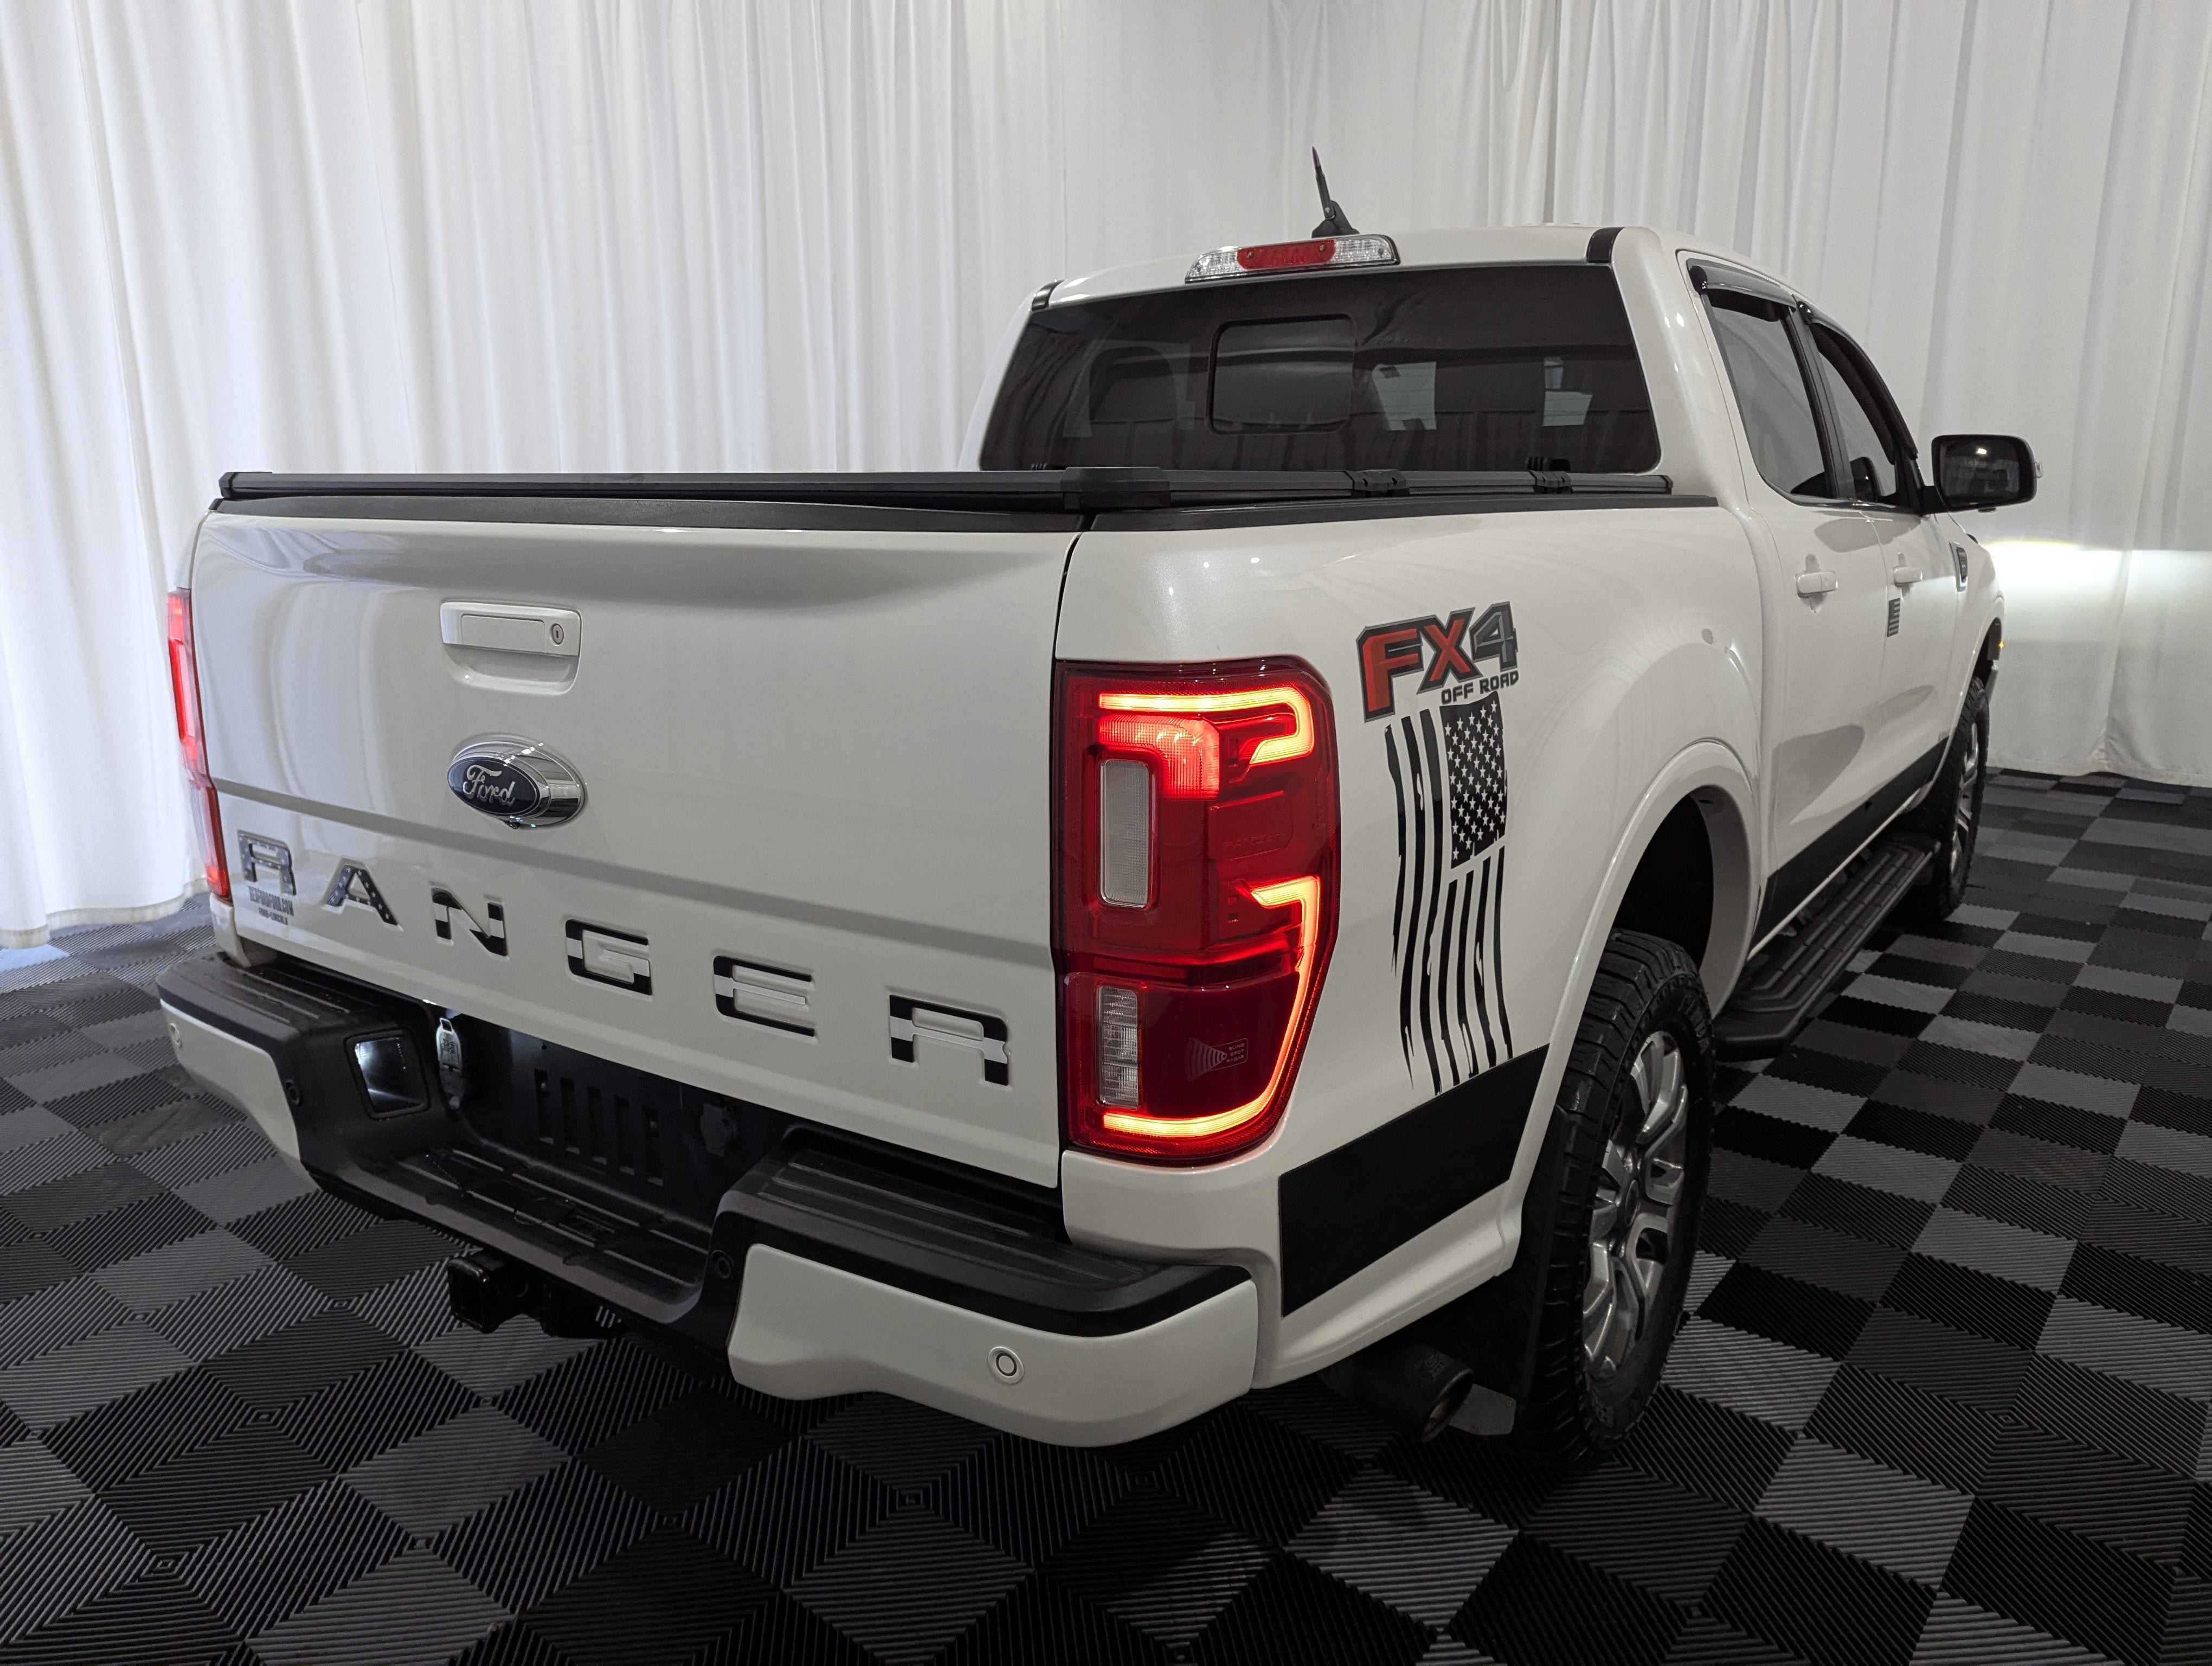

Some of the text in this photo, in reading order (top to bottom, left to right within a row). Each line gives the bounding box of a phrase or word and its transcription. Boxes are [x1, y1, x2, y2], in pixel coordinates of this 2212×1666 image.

[1356, 601, 1518, 723] FX4
[1441, 670, 1519, 705] OFF ROAD
[462, 764, 516, 806] Ford
[237, 830, 1009, 1086] RANGER
[1226, 1055, 1244, 1063] RADAR
